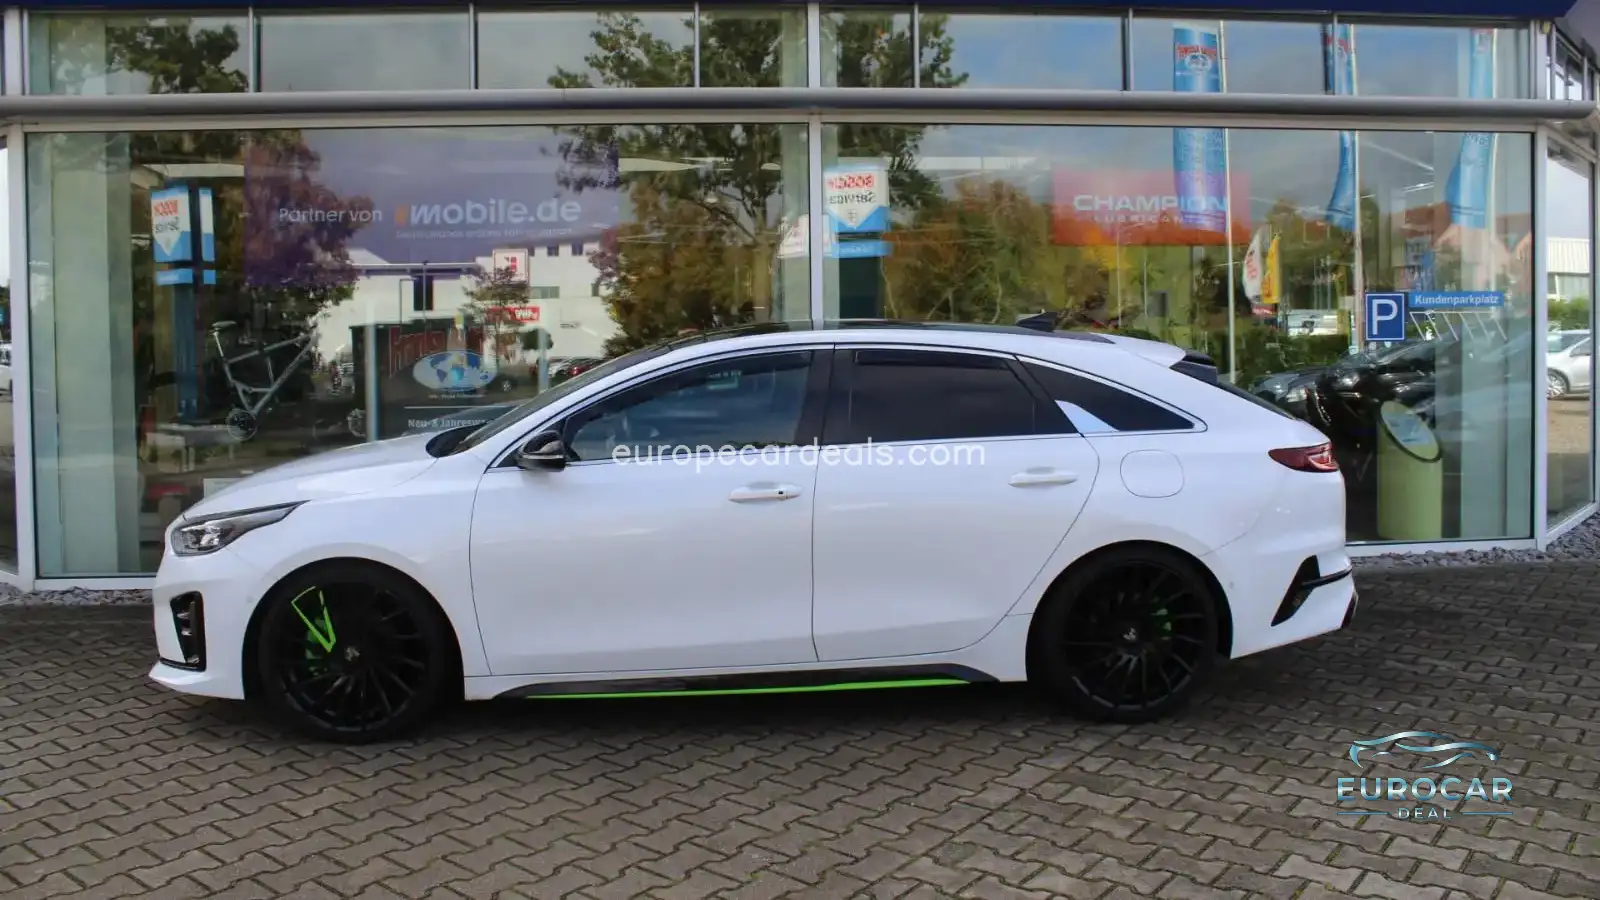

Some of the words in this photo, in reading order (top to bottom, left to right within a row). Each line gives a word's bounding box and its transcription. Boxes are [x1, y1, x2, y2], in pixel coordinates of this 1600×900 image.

[411, 197, 582, 226] mobile.de
[1073, 194, 1228, 212] CHAMPION
[278, 207, 344, 223] Partner
[348, 209, 383, 223] von
[1415, 294, 1499, 306] Kundenparkplatz
[1372, 299, 1398, 335] P
